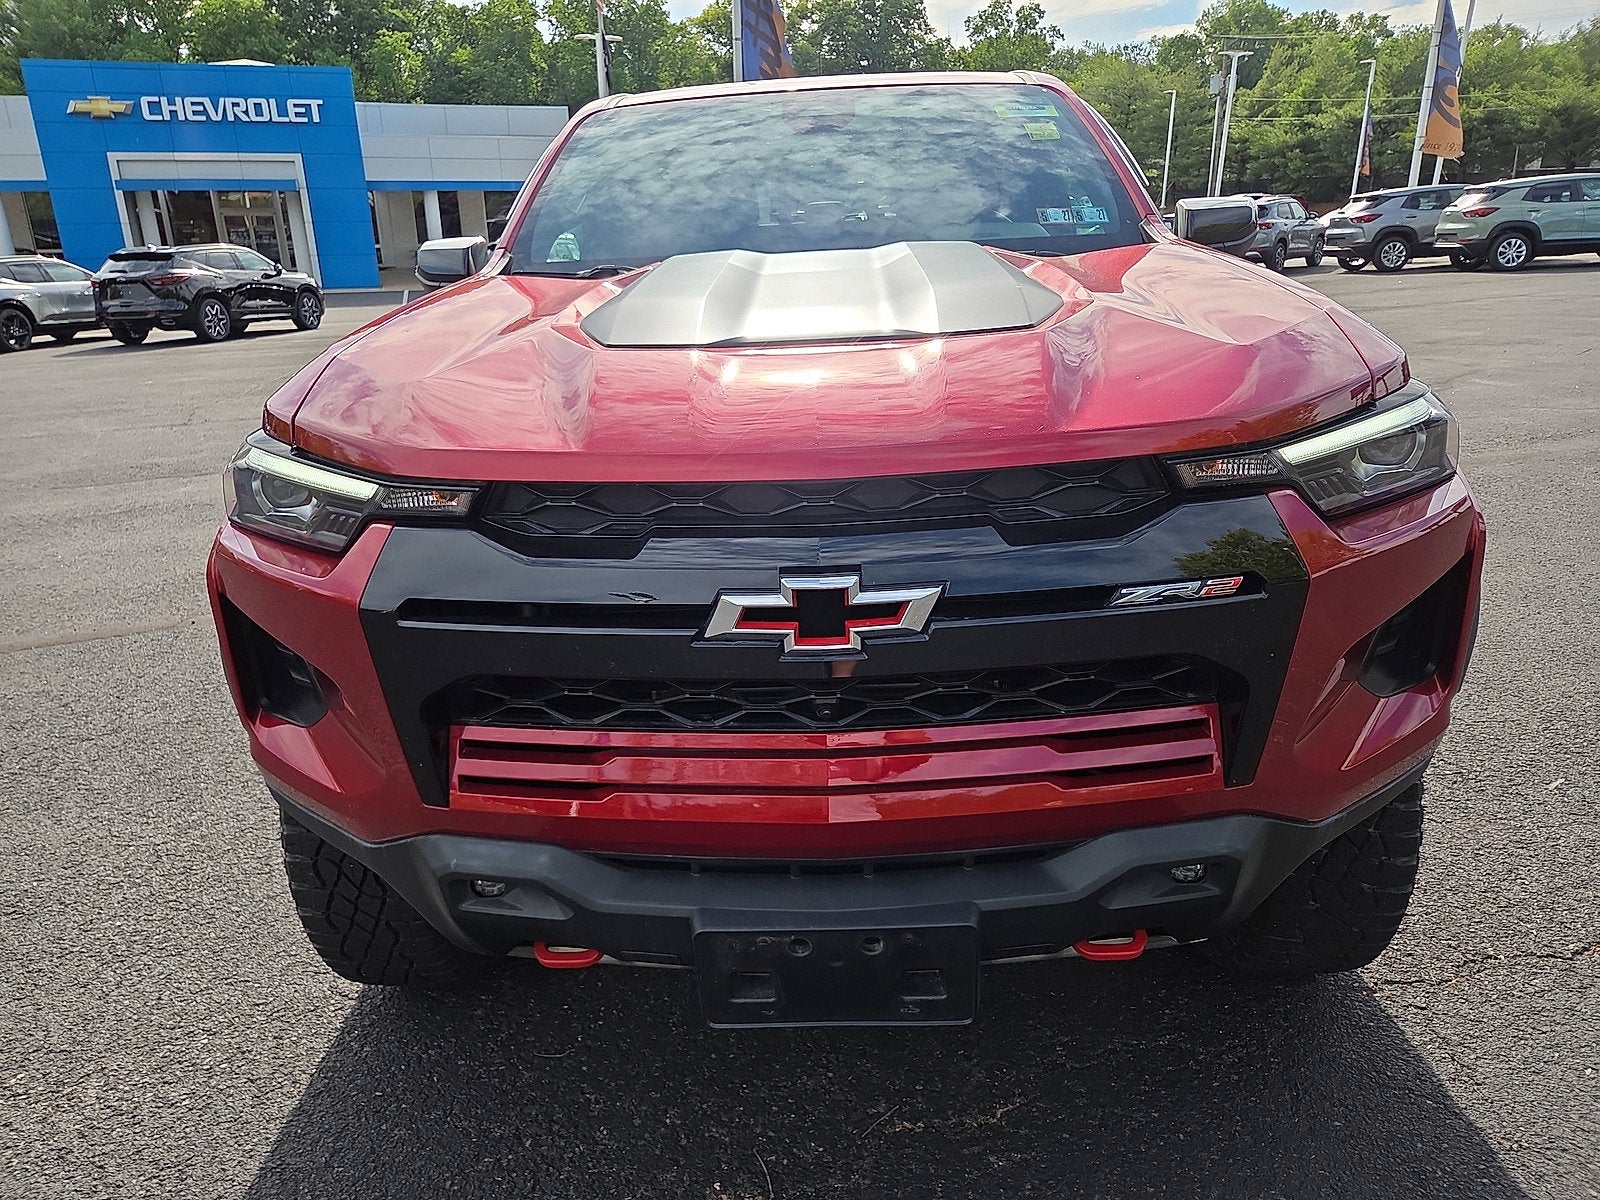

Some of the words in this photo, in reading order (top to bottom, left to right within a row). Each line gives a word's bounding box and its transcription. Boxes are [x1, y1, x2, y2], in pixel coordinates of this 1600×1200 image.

[139, 95, 324, 124] CHEVROLET
[1041, 211, 1048, 222] 5
[1076, 211, 1083, 221] 5
[1111, 576, 1244, 606] ZR2
